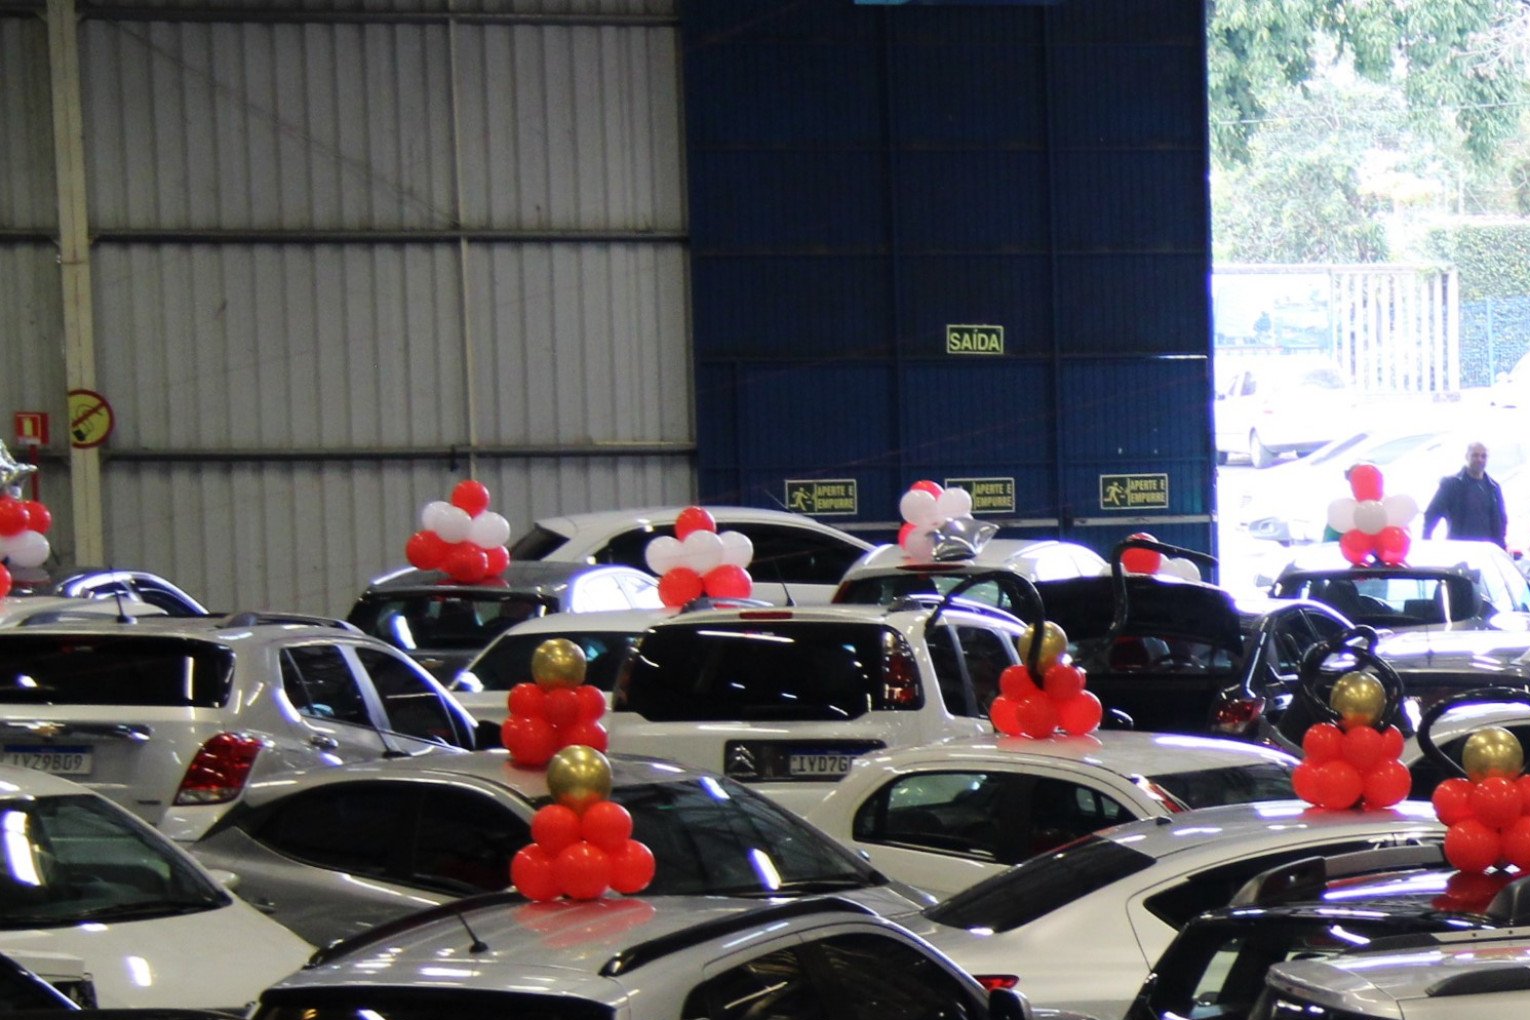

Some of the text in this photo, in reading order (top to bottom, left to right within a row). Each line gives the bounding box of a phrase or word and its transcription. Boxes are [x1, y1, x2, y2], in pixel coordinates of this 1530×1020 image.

[950, 328, 1001, 351] SAÍDA
[976, 482, 1012, 494] APERTE E
[1130, 479, 1166, 490] APERTE E
[817, 485, 846, 497] APERTE
[976, 496, 1012, 507] EMPURRE
[1130, 492, 1166, 503] EMPURRE
[817, 498, 854, 509] EMPURRE
[799, 756, 857, 772] IYD7G
